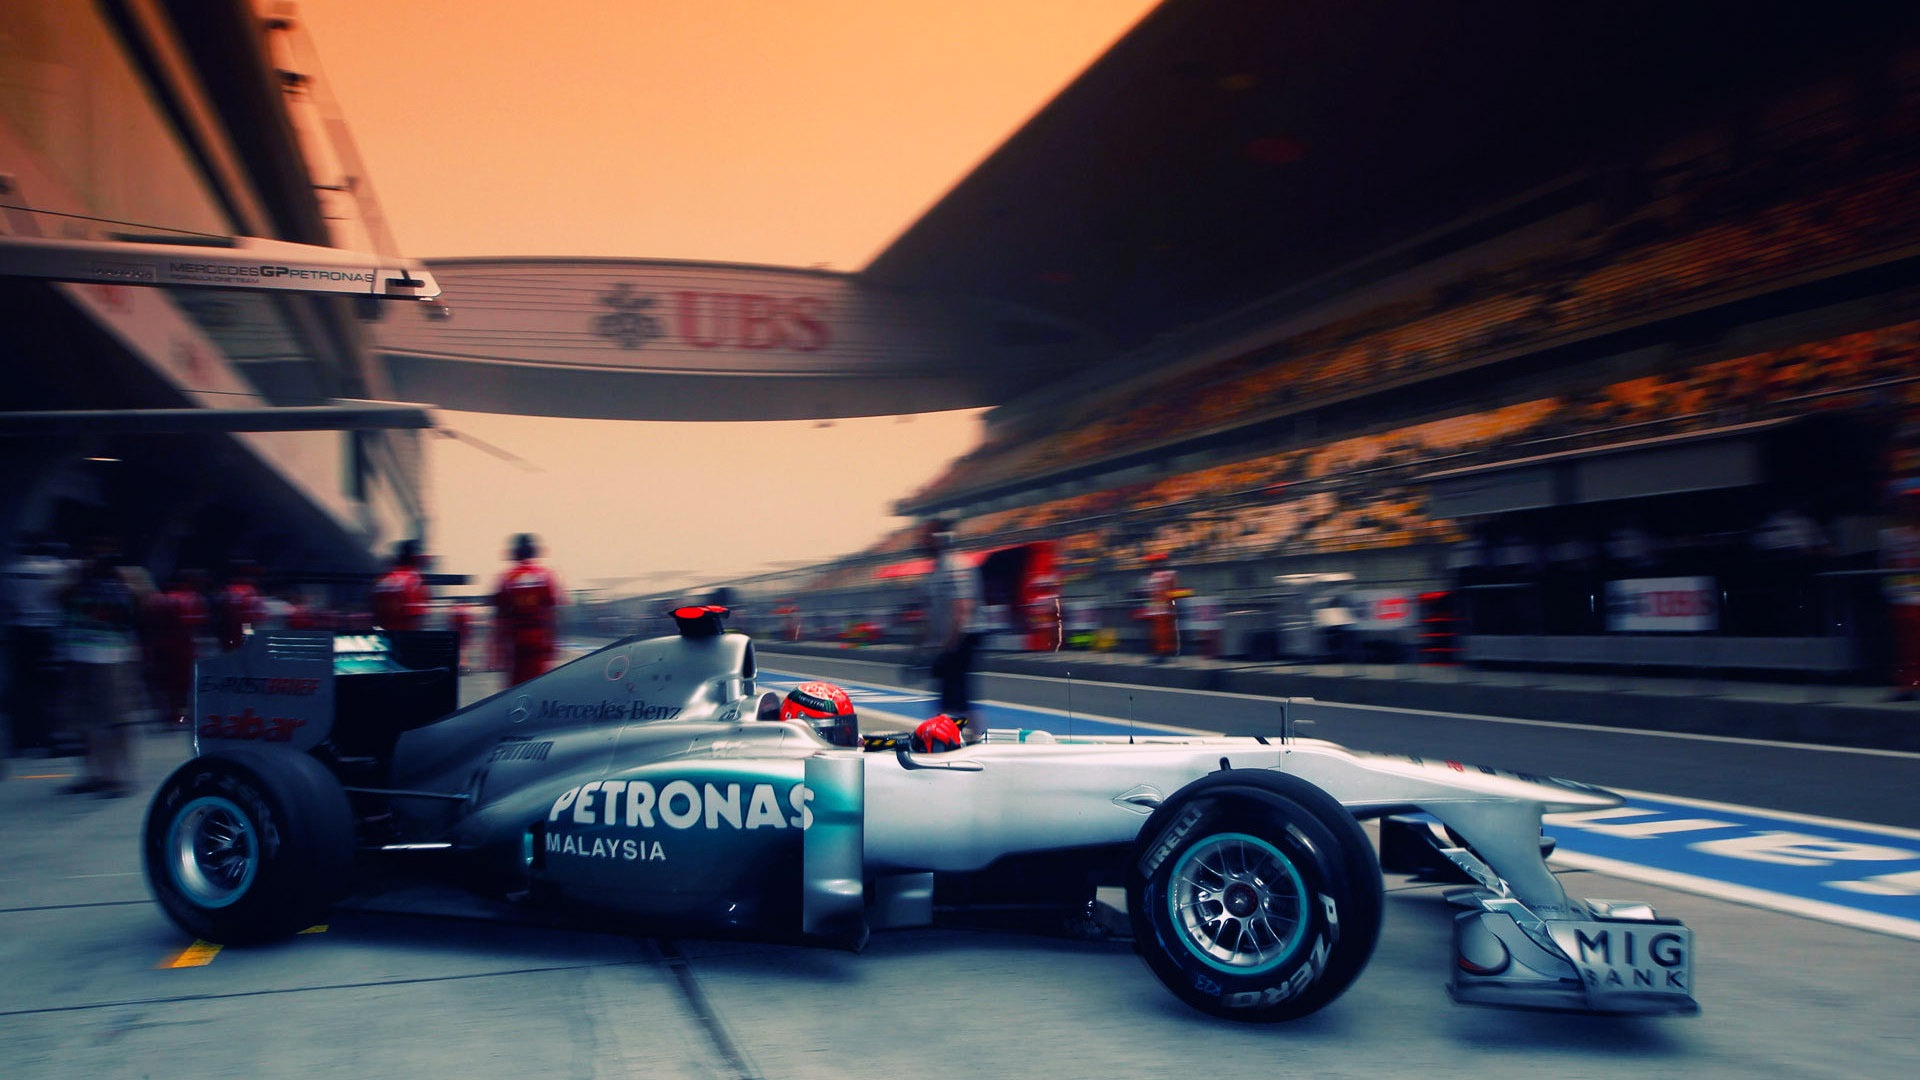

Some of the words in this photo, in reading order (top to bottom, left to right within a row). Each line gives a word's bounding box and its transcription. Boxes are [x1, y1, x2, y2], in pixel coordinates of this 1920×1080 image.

[677, 291, 831, 350] UBS
[199, 707, 306, 742] aabar
[537, 700, 683, 721] Mercedes-Benz
[548, 780, 815, 831] PETRONAS
[545, 831, 667, 861] MALAYSIA
[1574, 928, 1682, 968] MIG
[1223, 933, 1332, 1008] ZERO
[1583, 968, 1687, 989] BANK
